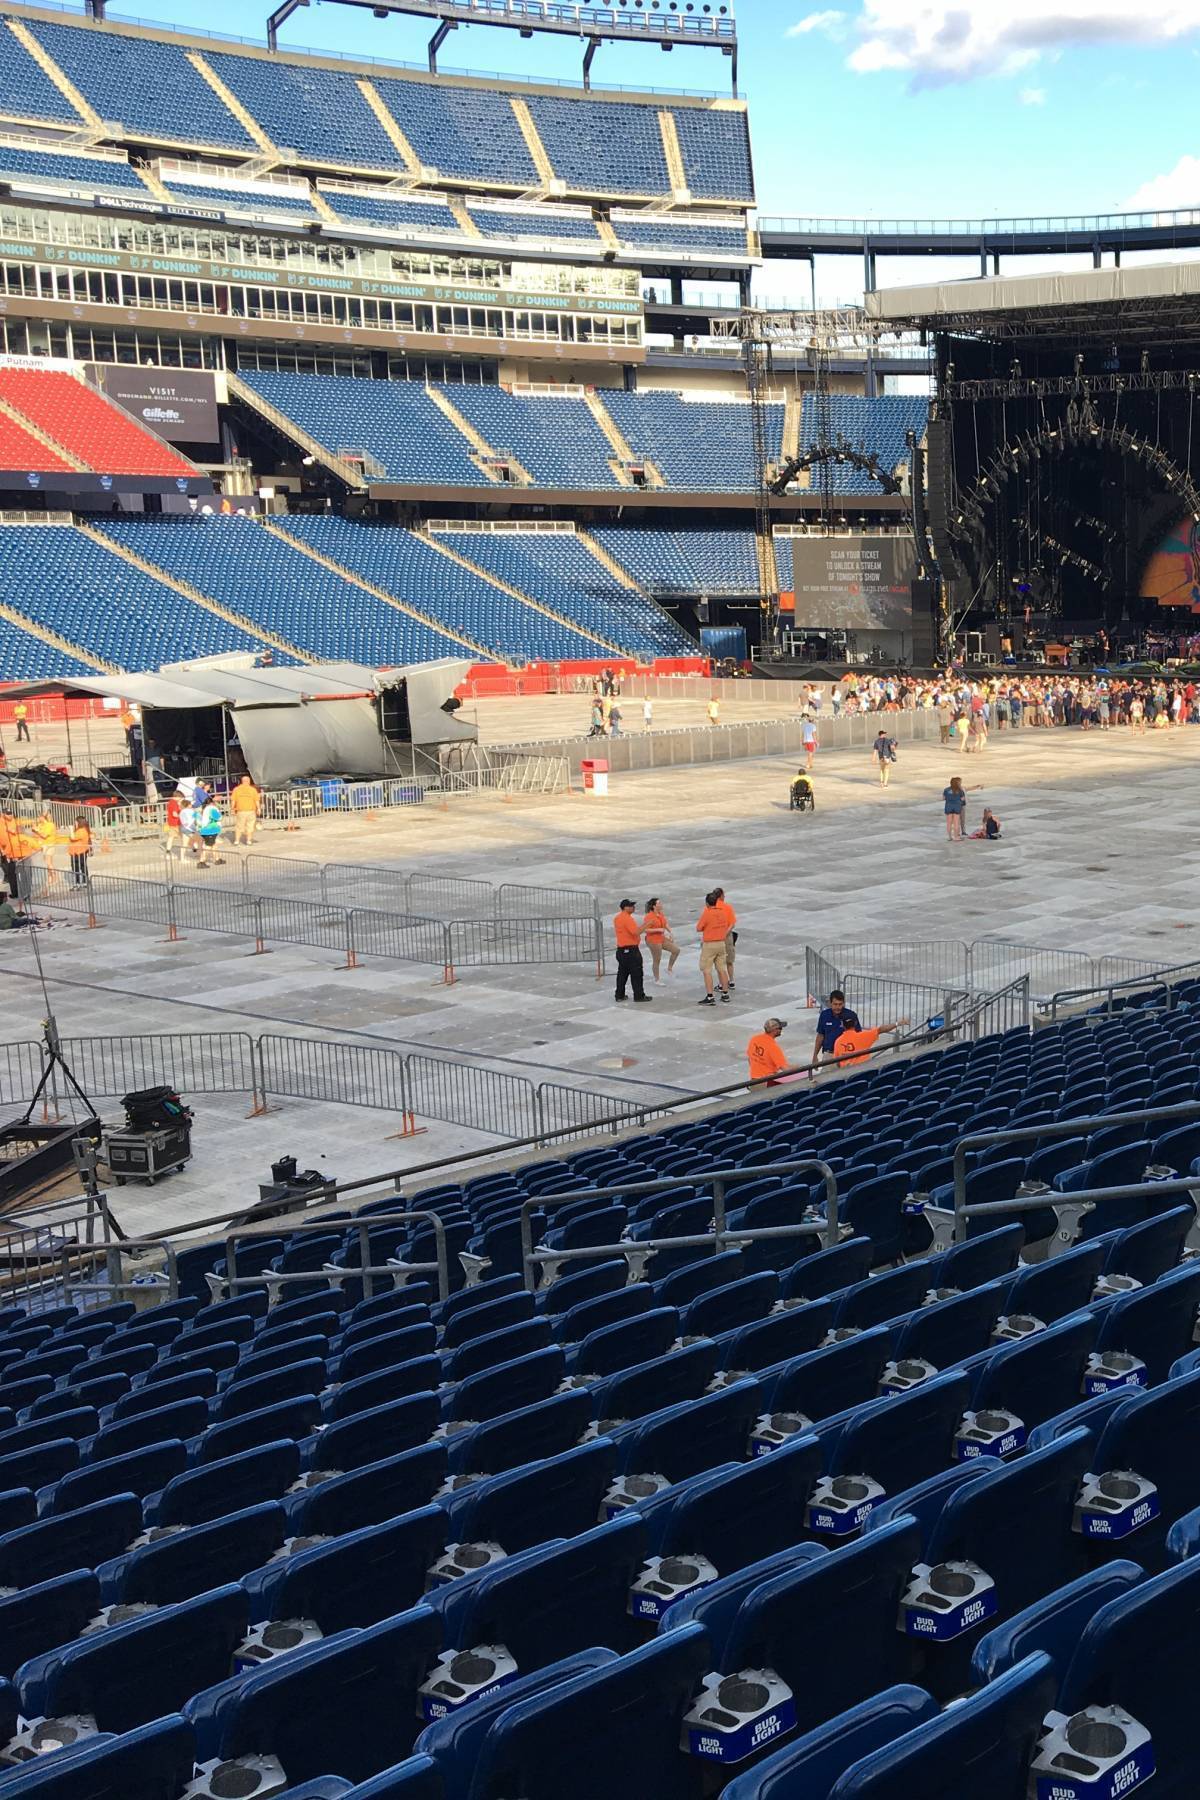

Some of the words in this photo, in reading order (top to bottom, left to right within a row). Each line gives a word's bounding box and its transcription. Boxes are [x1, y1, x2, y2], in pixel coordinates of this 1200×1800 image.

[100, 197, 121, 207] DELL
[121, 200, 163, 212] Technologies
[69, 252, 120, 265] DUNKIN'
[152, 260, 202, 273] DUNKIN'
[231, 269, 279, 282] DUNKIN'
[308, 277, 354, 289] DUNKIN'
[381, 285, 426, 296] DUNKIN'
[454, 290, 498, 302] DUNKIN'
[526, 297, 570, 307] DUNKIN'
[597, 301, 640, 311] DUNKIN'
[7, 357, 44, 367] Putnam
[150, 387, 175, 395] VISIT
[143, 408, 180, 418] Gillette
[861, 562, 881, 570] STREAM
[865, 573, 880, 581] SHOW
[1061, 1232, 1068, 1240] 12
[999, 1440, 1017, 1454] LIGHT
[1002, 1435, 1015, 1447] BUD
[857, 1504, 872, 1516] BUD
[1133, 1502, 1149, 1520] BUD
[1132, 1508, 1151, 1527] LIGHT
[816, 1520, 835, 1528] LIGHT
[1089, 1525, 1112, 1534] LIGHT
[1091, 1519, 1109, 1529] BUD
[640, 1606, 659, 1615] LIGHT
[642, 1600, 656, 1609] BUD
[963, 1600, 982, 1618] BUD
[916, 1616, 934, 1626] BUD
[960, 1605, 985, 1628] LIGHT
[913, 1622, 938, 1634] LIGHT
[432, 1704, 447, 1712] BUD
[754, 1715, 777, 1736] BUD
[751, 1720, 781, 1746] LIGHT
[701, 1737, 720, 1747] BUD
[698, 1744, 724, 1756] LIGHT
[1114, 1760, 1135, 1783] BUD
[1111, 1767, 1140, 1798] LIGHT
[1052, 1787, 1075, 1798] BUD
